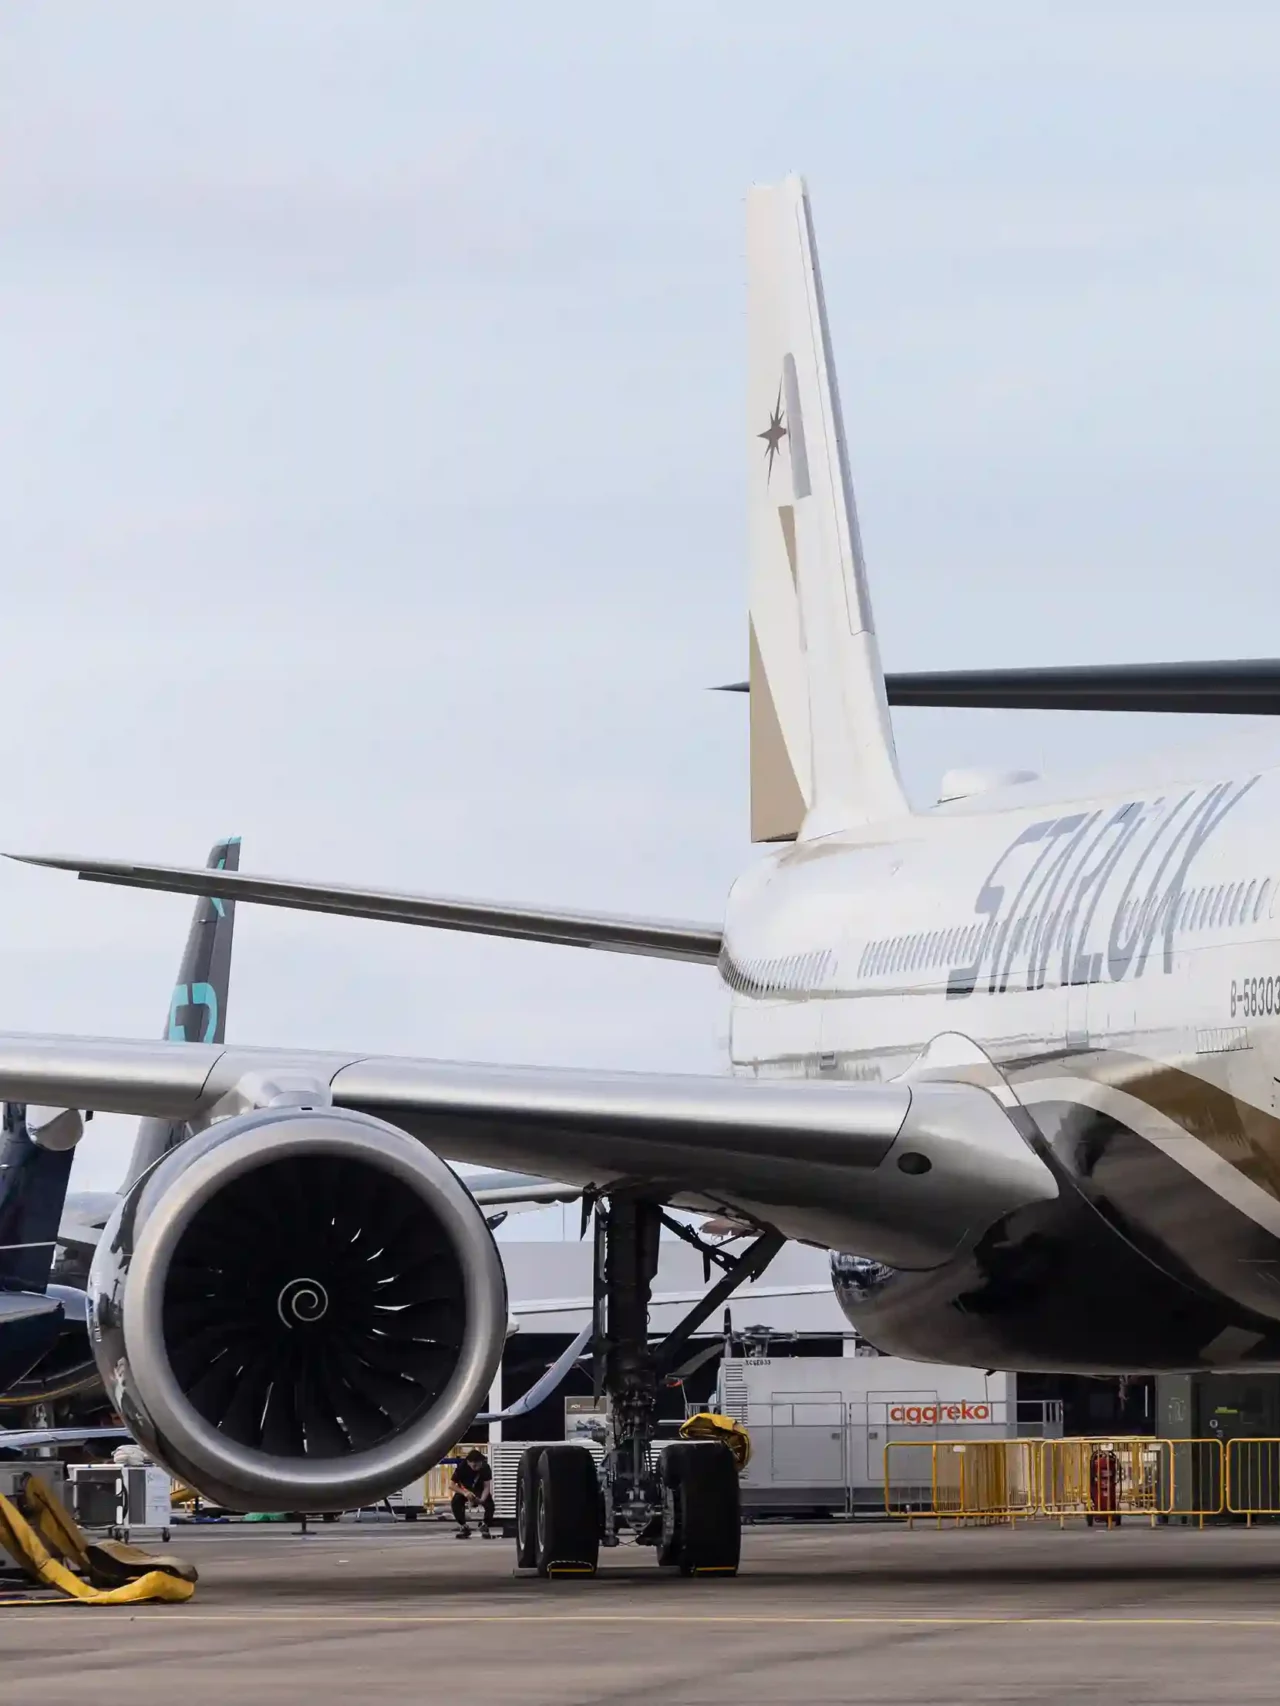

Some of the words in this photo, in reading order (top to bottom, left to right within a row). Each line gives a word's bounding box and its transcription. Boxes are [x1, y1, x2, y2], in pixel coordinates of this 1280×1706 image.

[946, 775, 1262, 1000] STARLUX
[1231, 975, 1280, 1018] B-58303
[890, 1399, 989, 1425] aggreko
